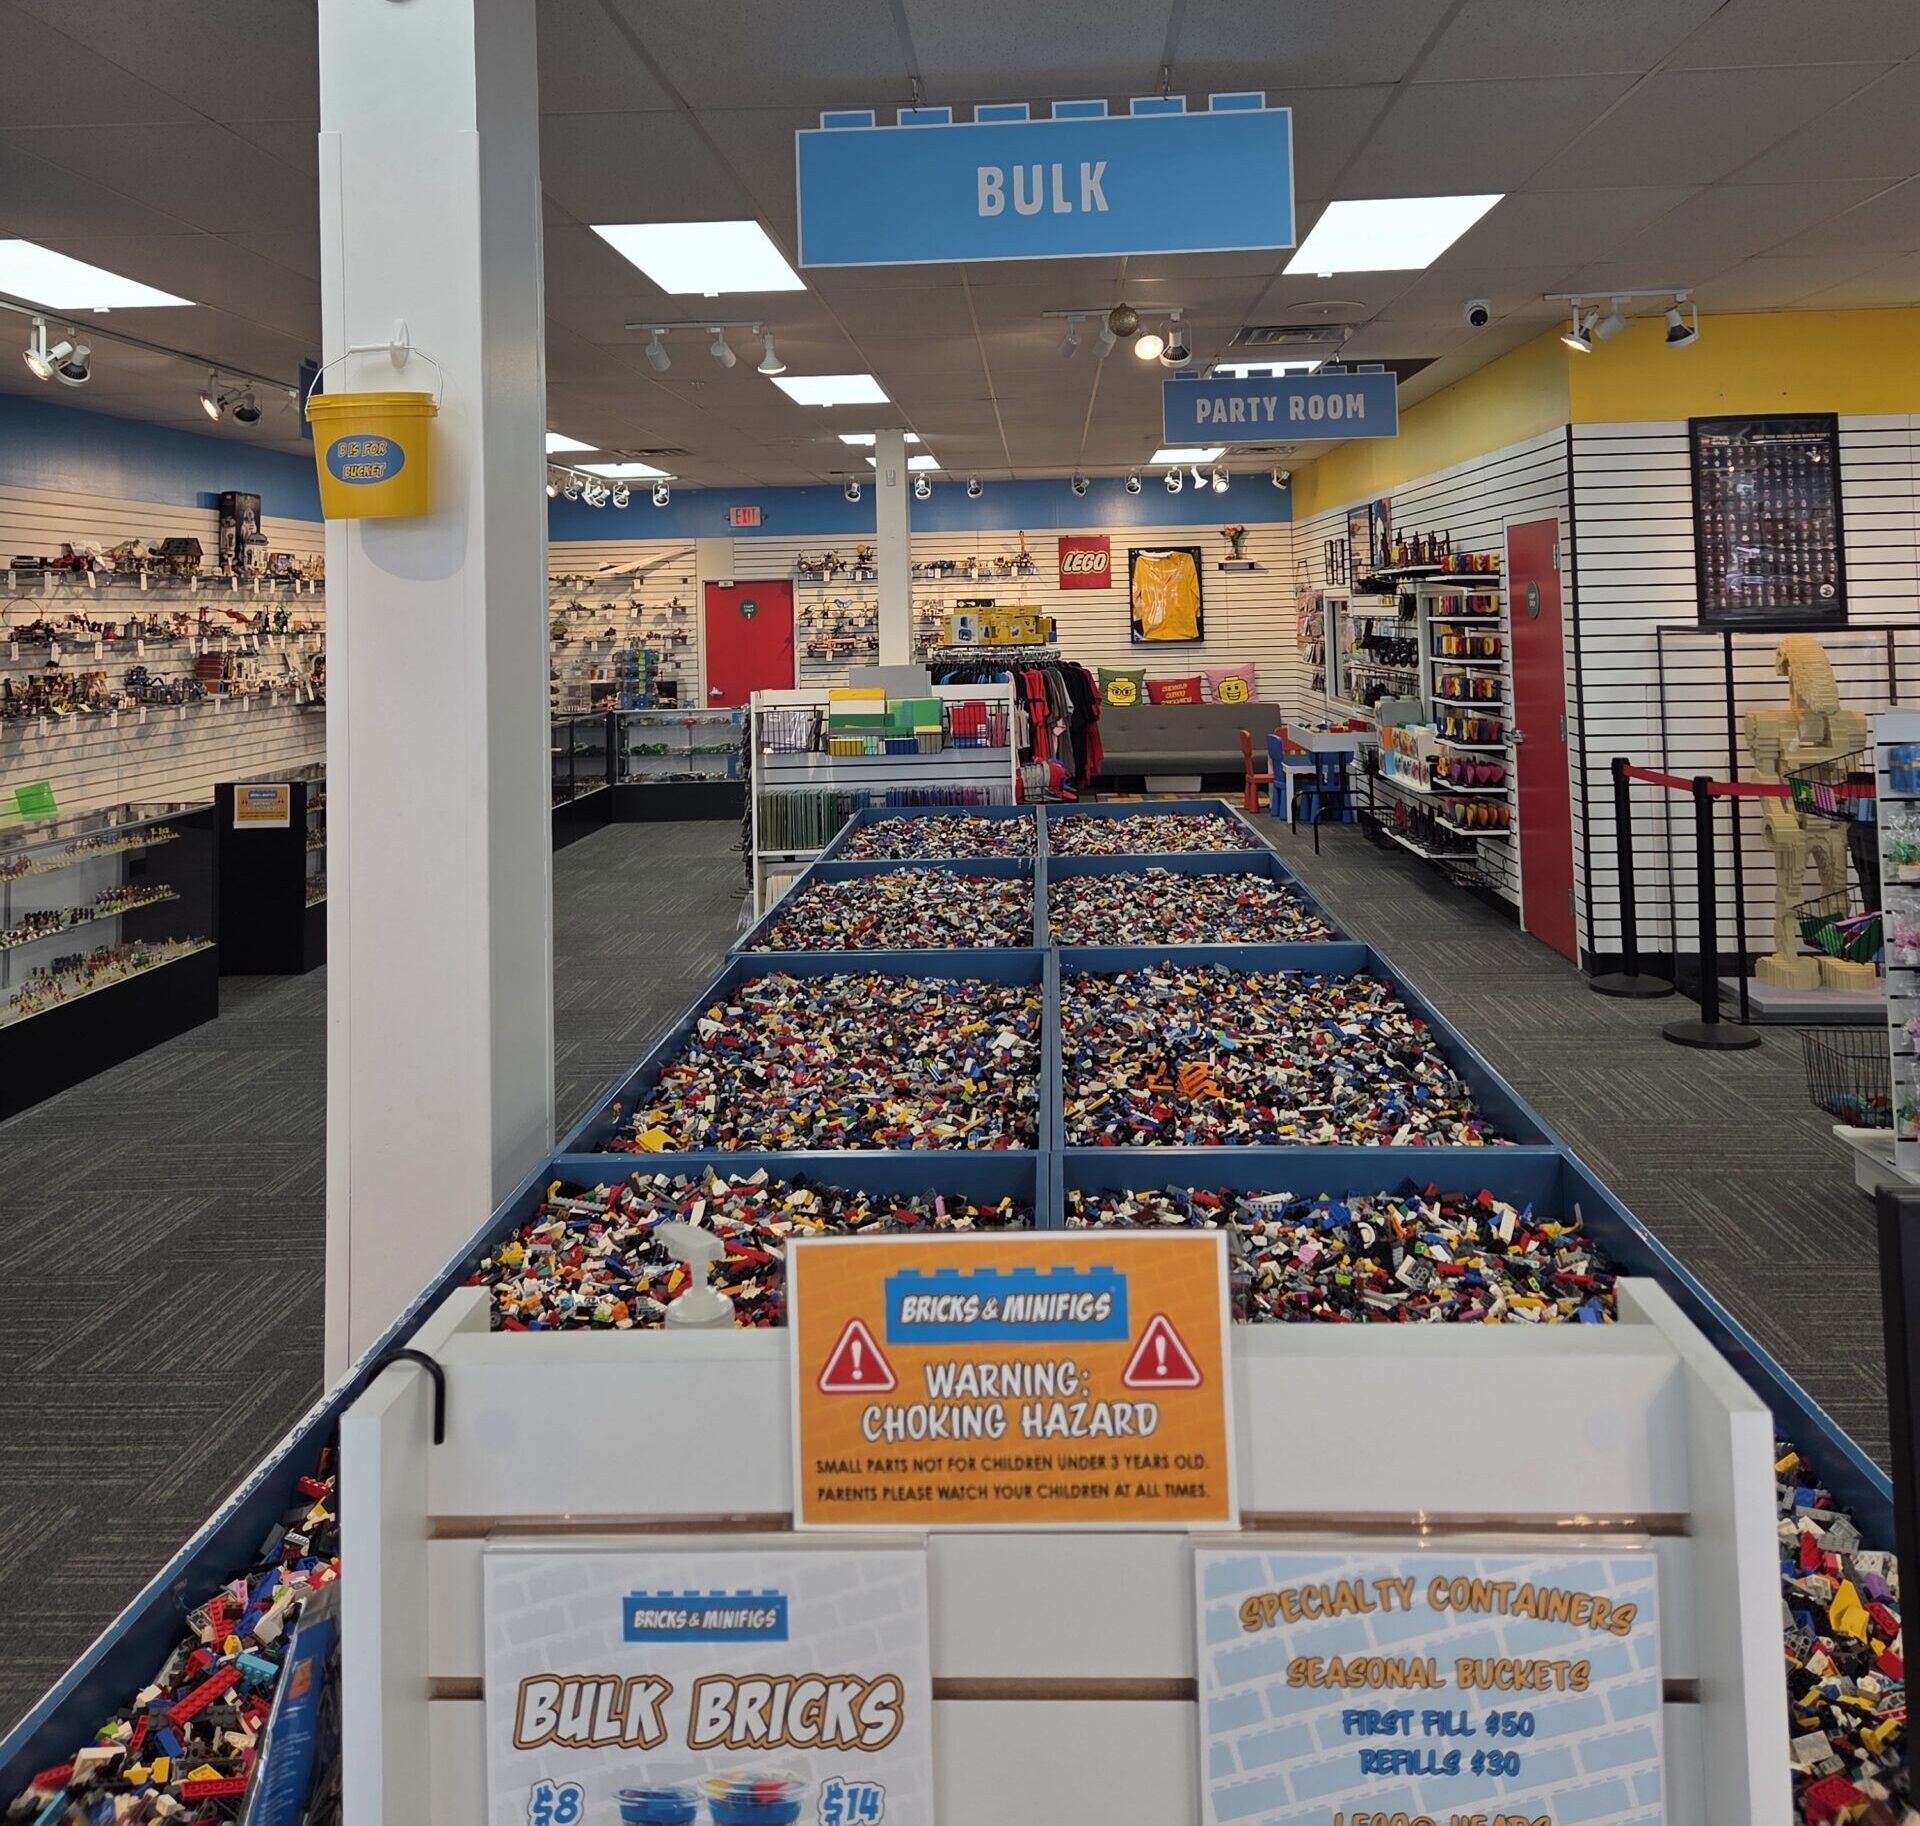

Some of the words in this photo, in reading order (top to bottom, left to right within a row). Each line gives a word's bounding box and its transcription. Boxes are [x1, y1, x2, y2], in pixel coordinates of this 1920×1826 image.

[977, 161, 1109, 217] BULK
[1196, 397, 1277, 424] PARTY
[1289, 393, 1365, 421] ROOM
[338, 443, 347, 457] B
[348, 442, 360, 457] IS
[362, 440, 387, 456] FOR
[343, 462, 387, 479] BUCKET
[735, 508, 758, 524] EXIT
[1061, 551, 1109, 574] LEGO
[900, 1294, 980, 1323] BRICKS
[981, 1297, 998, 1321] &
[1001, 1292, 1112, 1322] MINIFIGS
[925, 1360, 1090, 1399] WARNING:
[862, 1402, 1007, 1442] CHOKING
[1021, 1401, 1158, 1439] HAZARD
[816, 1459, 862, 1474] SMALL
[867, 1458, 908, 1473] PARTS
[913, 1457, 942, 1472] NOT
[948, 1457, 976, 1472] FOR
[981, 1456, 1053, 1472] CHILDREN
[1057, 1455, 1105, 1471] UNDER
[1111, 1455, 1119, 1470] 3
[1124, 1455, 1169, 1470] YEARS
[818, 1487, 877, 1501] PARENTS
[882, 1486, 932, 1501] PLEASE
[938, 1486, 987, 1500] WATCH
[993, 1485, 1032, 1499] YOUR
[1037, 1485, 1109, 1499] CHILDREN
[1114, 1484, 1130, 1498] AT
[1136, 1484, 1160, 1498] ALL
[633, 1609, 687, 1630] BRICKS
[689, 1613, 700, 1627] &
[702, 1607, 777, 1630] MINIFIGS
[1239, 1576, 1415, 1633] SPECIALTY
[1427, 1576, 1638, 1636] CONTAINERS
[1286, 1656, 1446, 1690] SEASONAL
[1455, 1658, 1591, 1692] BUCKETS
[514, 1674, 673, 1750] BULK
[687, 1673, 904, 1751] BRICKS
[1342, 1709, 1413, 1737] FIRST
[1421, 1709, 1476, 1737] FILL
[1485, 1710, 1535, 1738] $50
[1359, 1749, 1461, 1777] REFILLS
[1470, 1750, 1521, 1777] $30
[532, 1782, 580, 1826] $8
[821, 1781, 881, 1826] $14
